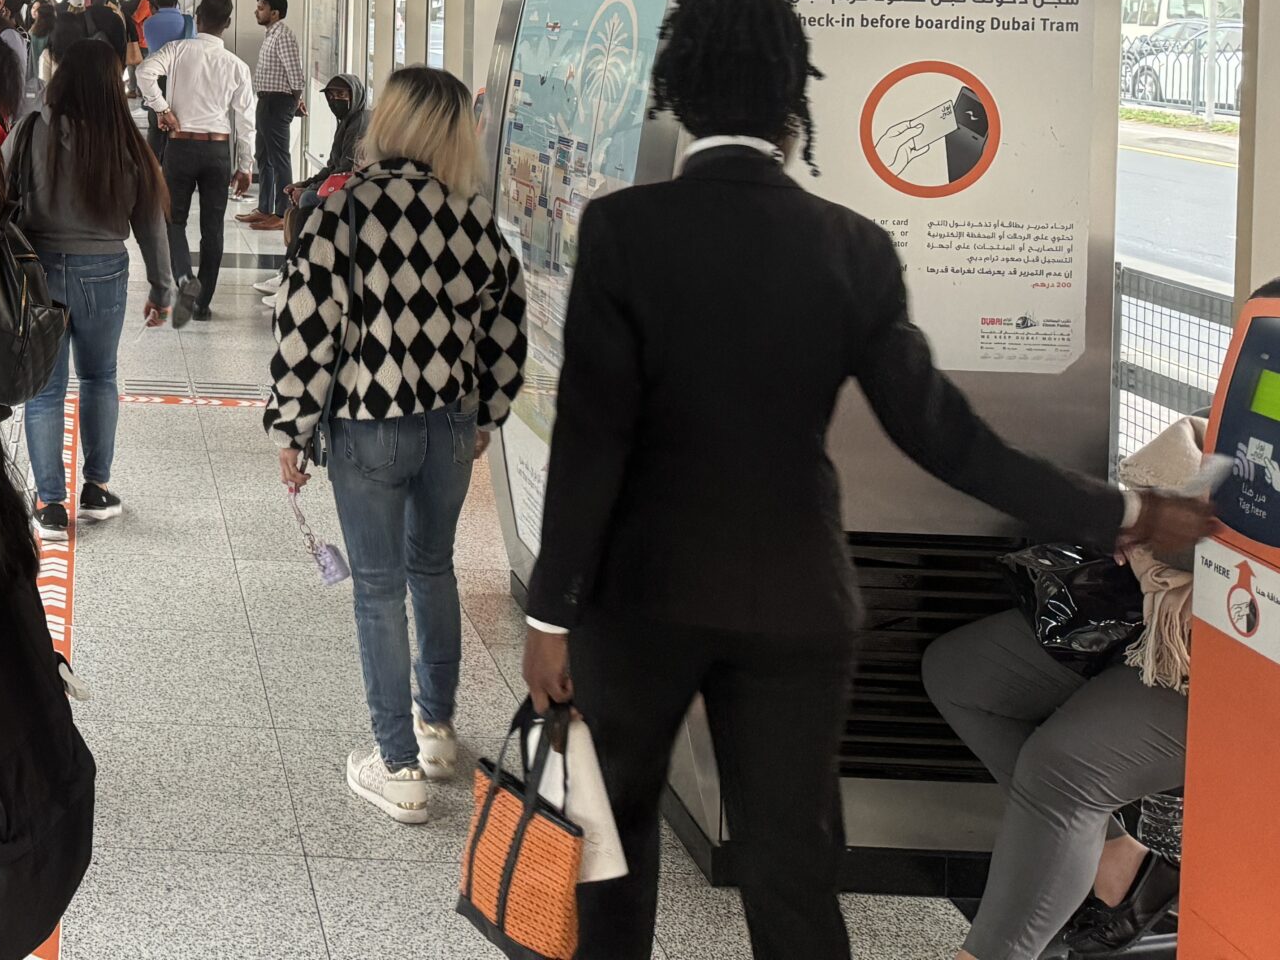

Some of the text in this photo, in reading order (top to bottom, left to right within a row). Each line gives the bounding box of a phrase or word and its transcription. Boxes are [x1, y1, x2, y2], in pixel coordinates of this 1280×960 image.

[798, 13, 1079, 33] heck-in before boarding Dubai Tram
[926, 266, 948, 274] قدرها
[951, 266, 975, 275] لغرامة
[977, 267, 1005, 276] يعرضك
[981, 318, 1002, 326] DUBAI
[1241, 482, 1254, 497] هنا
[1238, 498, 1267, 519] Tag here
[1201, 556, 1230, 579] TAP HERE
